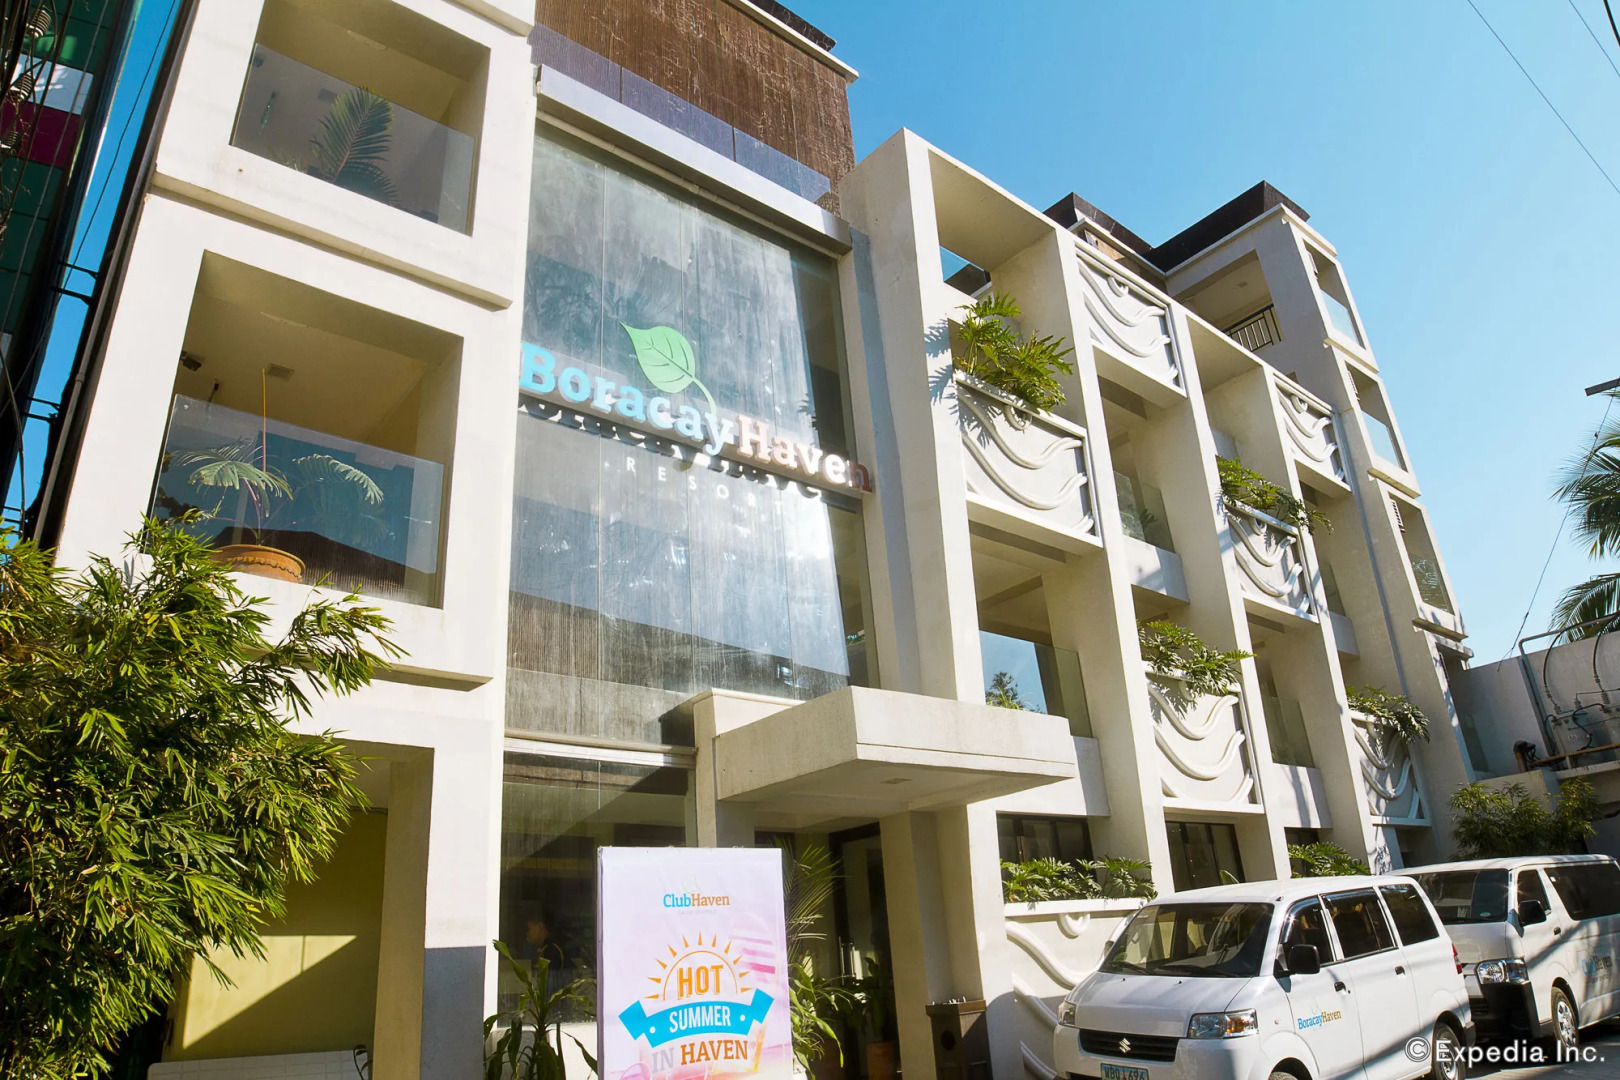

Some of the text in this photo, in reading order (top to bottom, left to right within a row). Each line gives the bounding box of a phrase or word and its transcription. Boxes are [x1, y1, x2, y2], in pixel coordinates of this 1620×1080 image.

[519, 341, 873, 494] BoracayHaven
[663, 893, 731, 908] ClubHaven
[677, 964, 724, 1000] HOT
[669, 1005, 731, 1033] SUMMER
[1297, 1010, 1342, 1030] BoracayHaven
[652, 1039, 748, 1073] IN HAVEN
